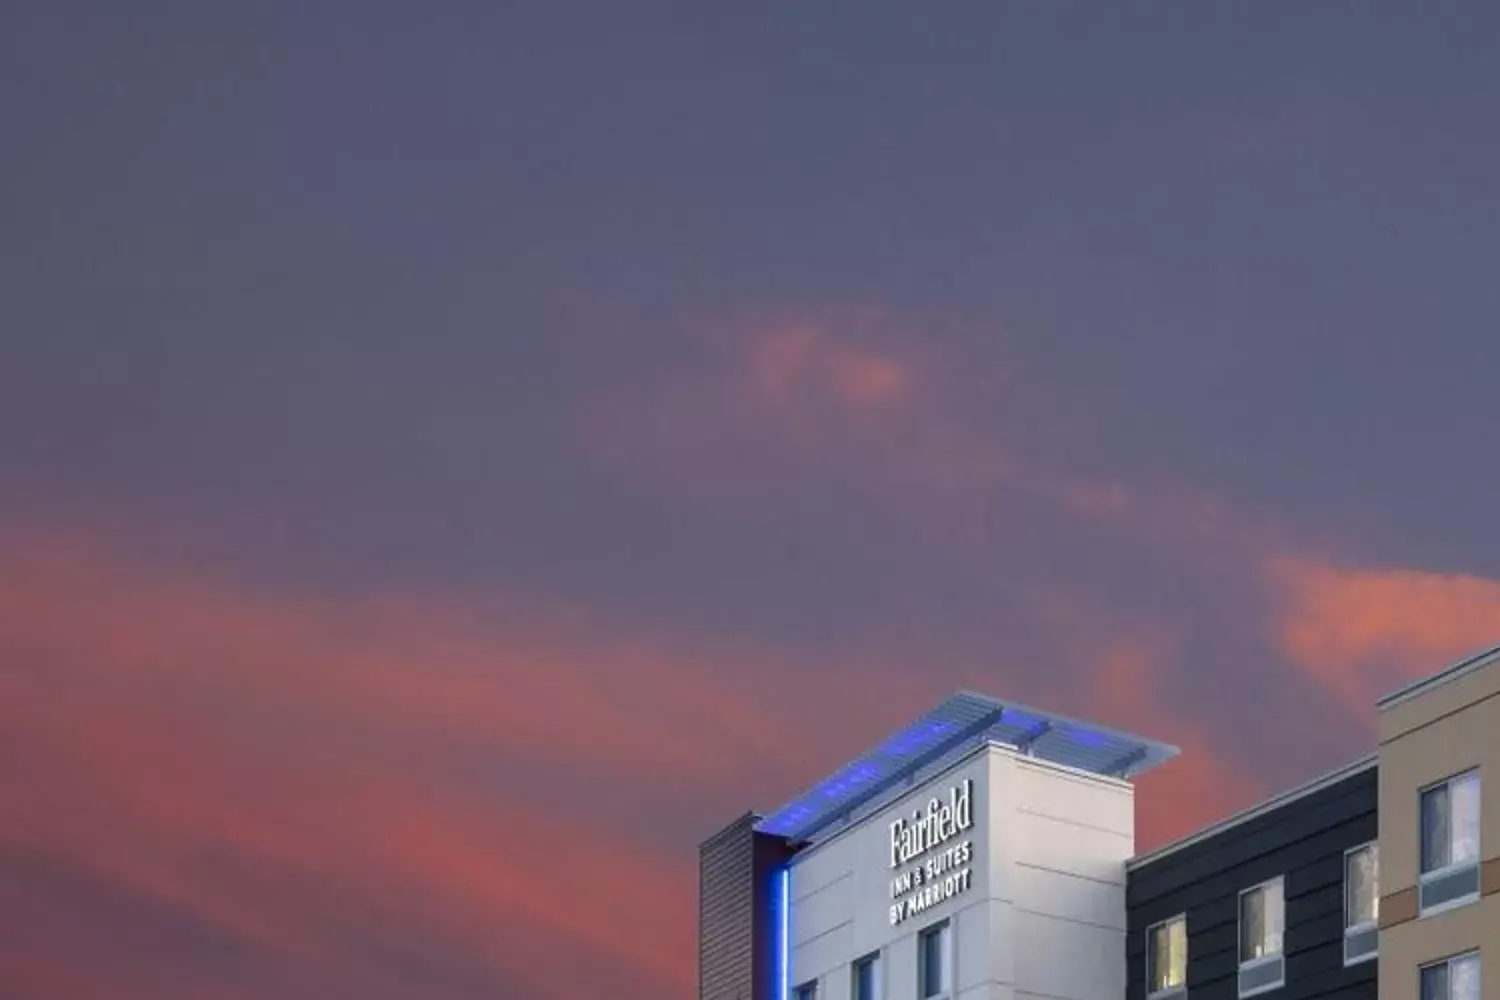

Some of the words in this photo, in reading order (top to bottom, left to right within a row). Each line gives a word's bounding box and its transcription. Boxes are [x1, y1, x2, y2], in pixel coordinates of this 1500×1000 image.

[889, 779, 972, 869] Fairfield
[889, 899, 906, 926] BY
[907, 868, 970, 916] MARRIOTT
[890, 871, 911, 900] INN
[914, 866, 922, 884] &
[926, 841, 971, 880] SUITES
